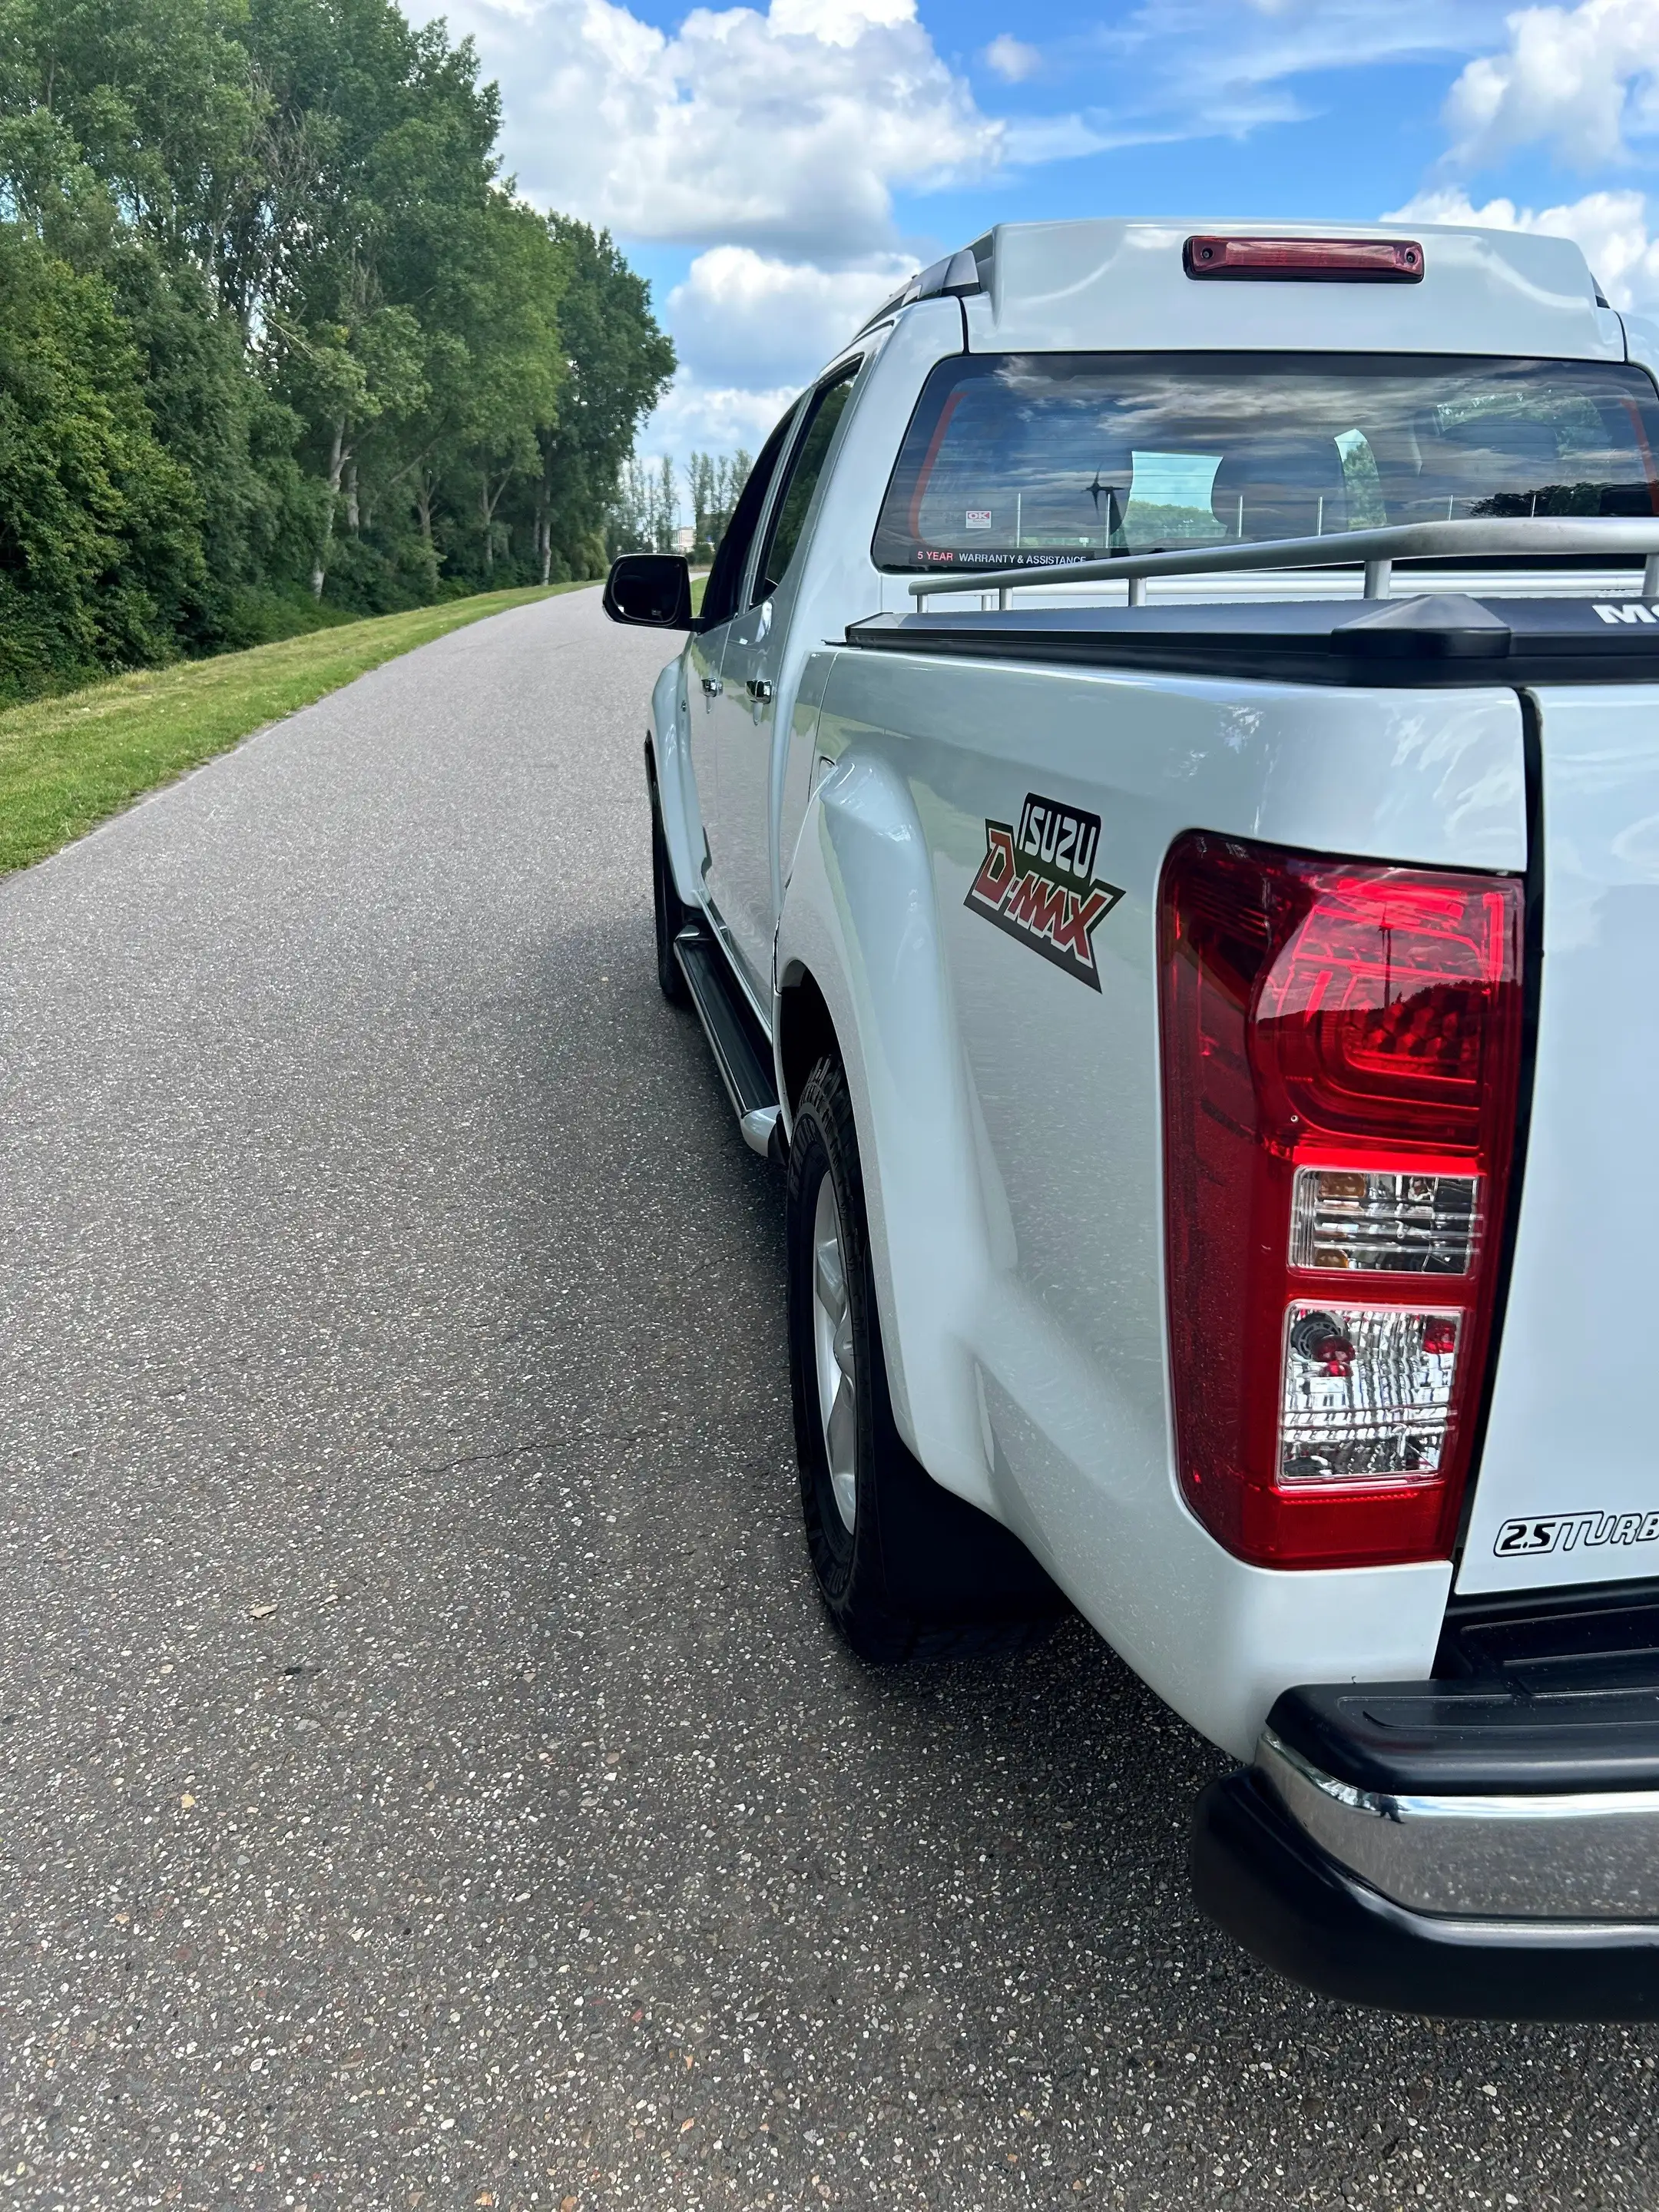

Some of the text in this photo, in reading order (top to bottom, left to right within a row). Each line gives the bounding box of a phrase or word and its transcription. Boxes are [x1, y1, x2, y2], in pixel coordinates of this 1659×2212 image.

[917, 551, 924, 560] 5
[926, 551, 953, 561] YEAR
[959, 552, 1016, 565] WARRANTY
[1017, 555, 1024, 565] &
[1591, 604, 1659, 624] M
[1019, 803, 1097, 879] ISUZU
